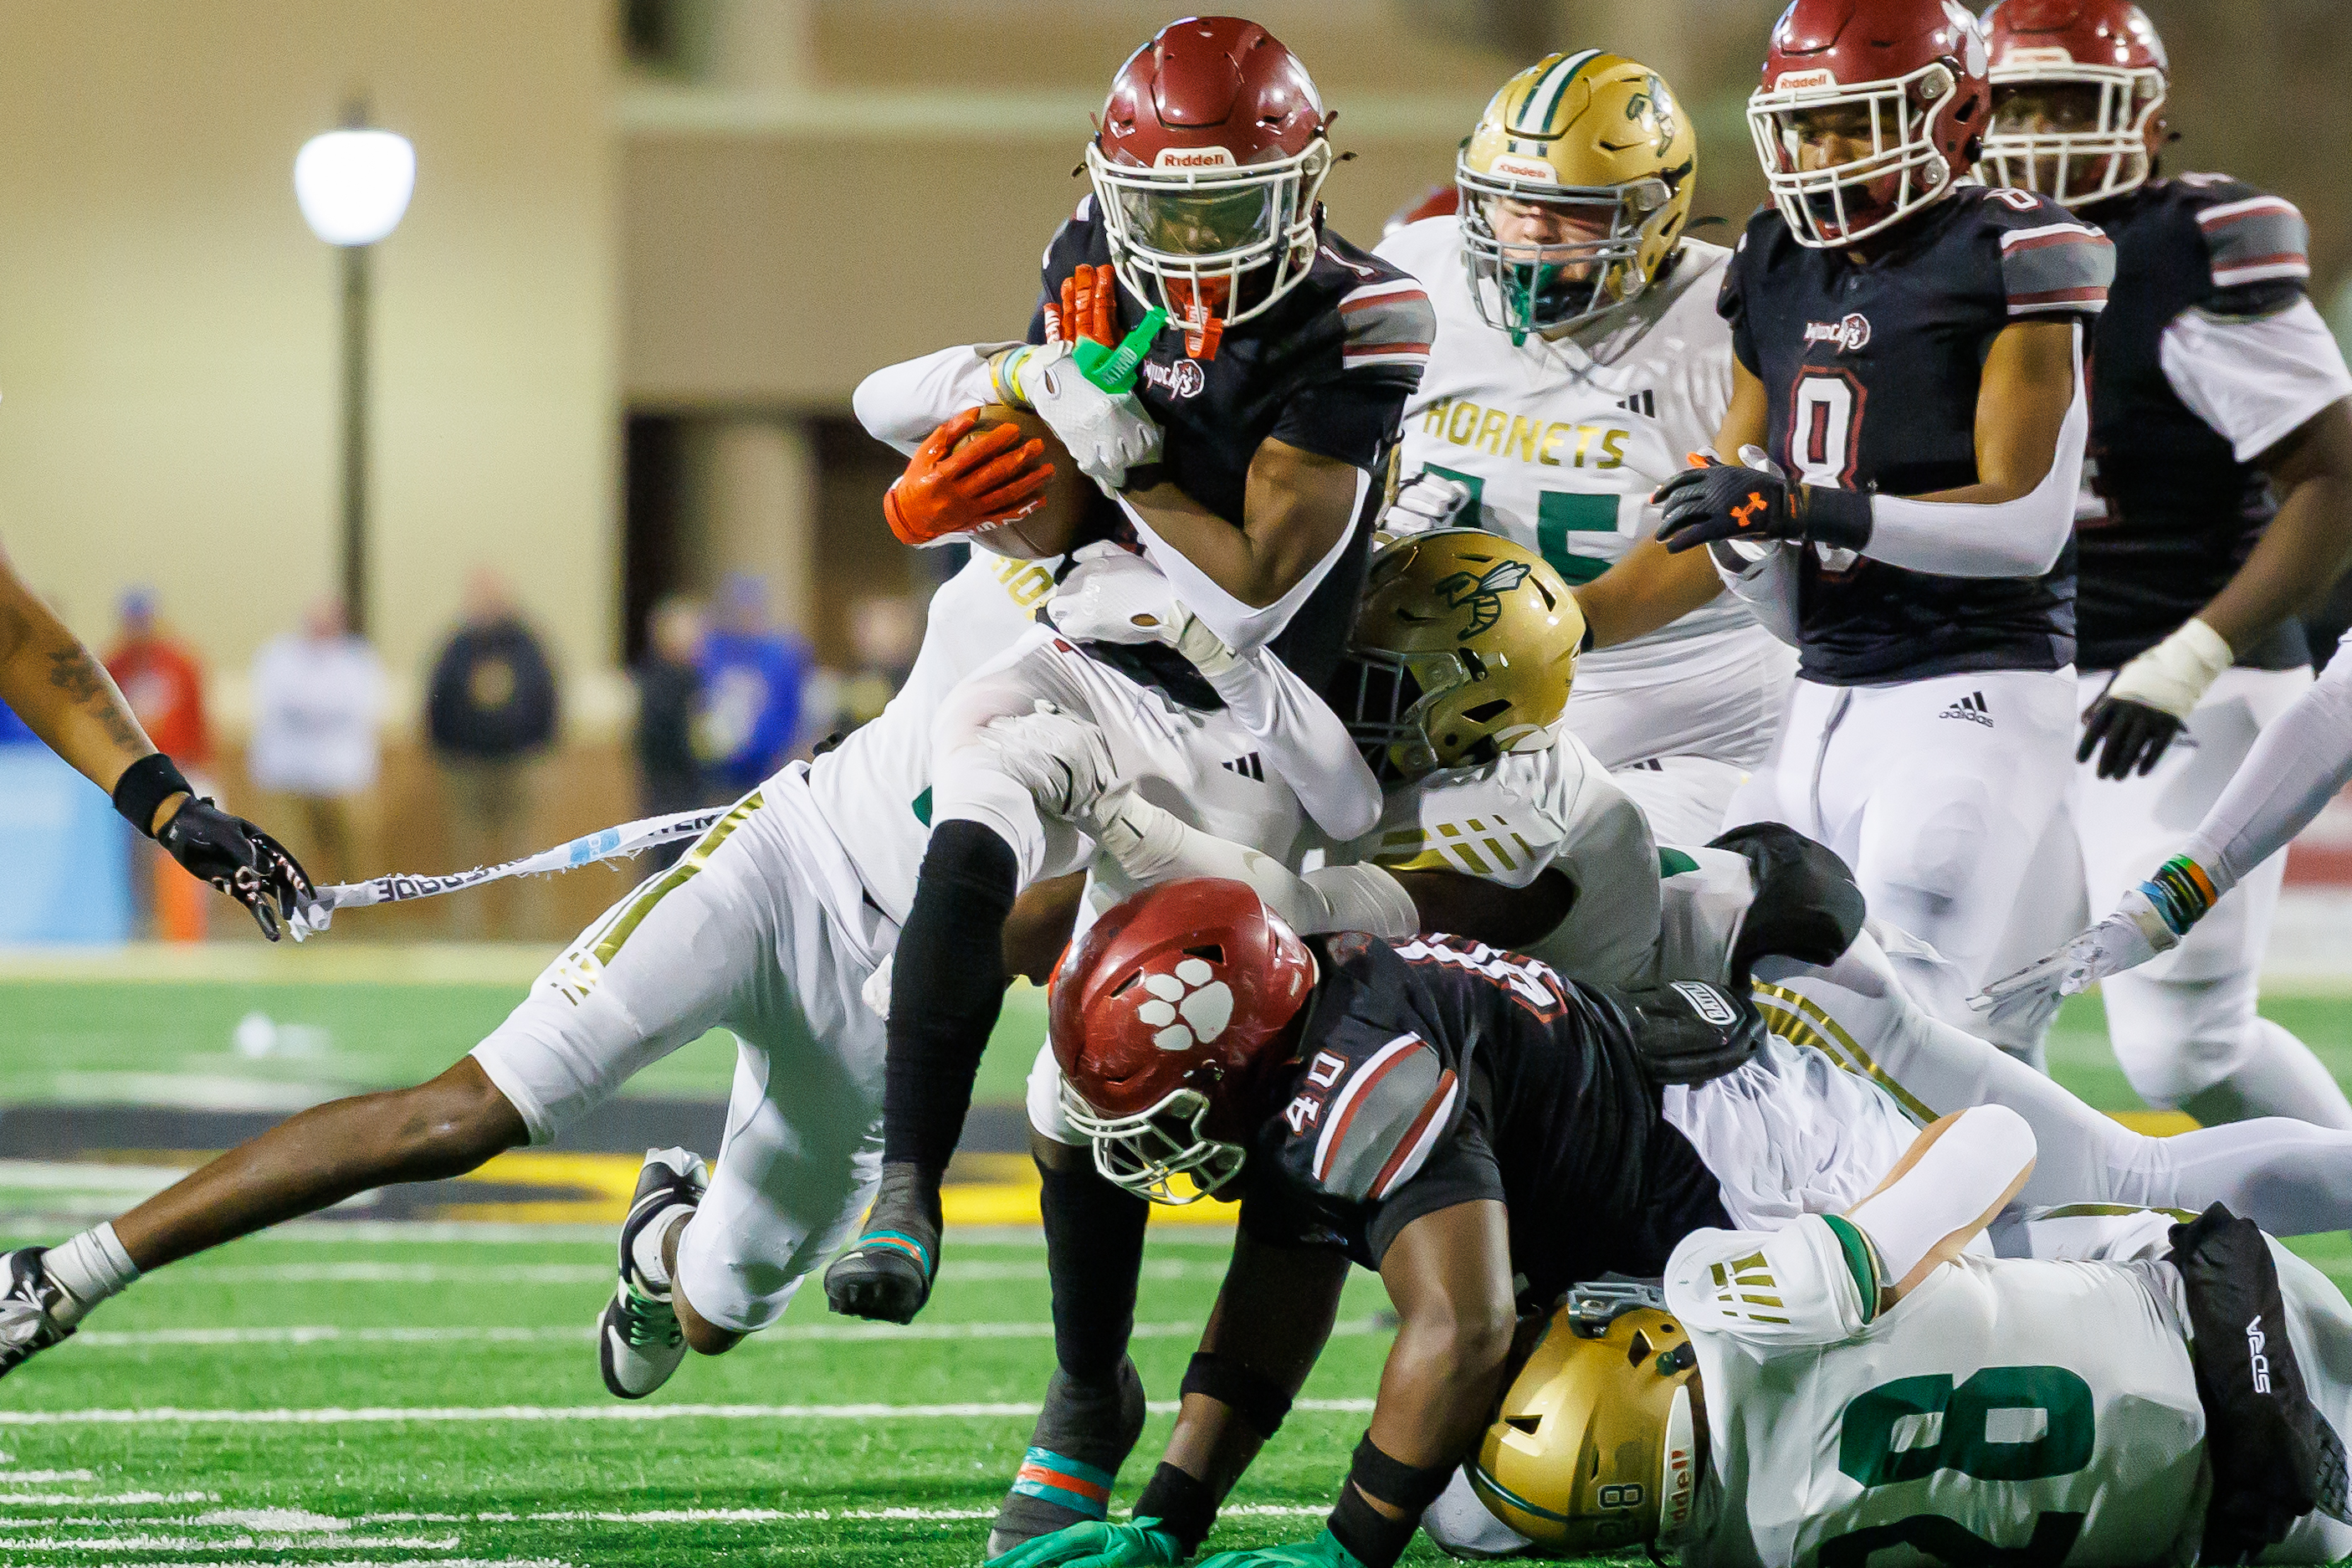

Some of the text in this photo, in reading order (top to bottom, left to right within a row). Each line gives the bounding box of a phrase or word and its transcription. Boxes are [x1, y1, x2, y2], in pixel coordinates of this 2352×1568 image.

[1164, 154, 1225, 167] Riddell
[1423, 397, 1629, 469] HORNETS
[1284, 1048, 1348, 1134] 40
